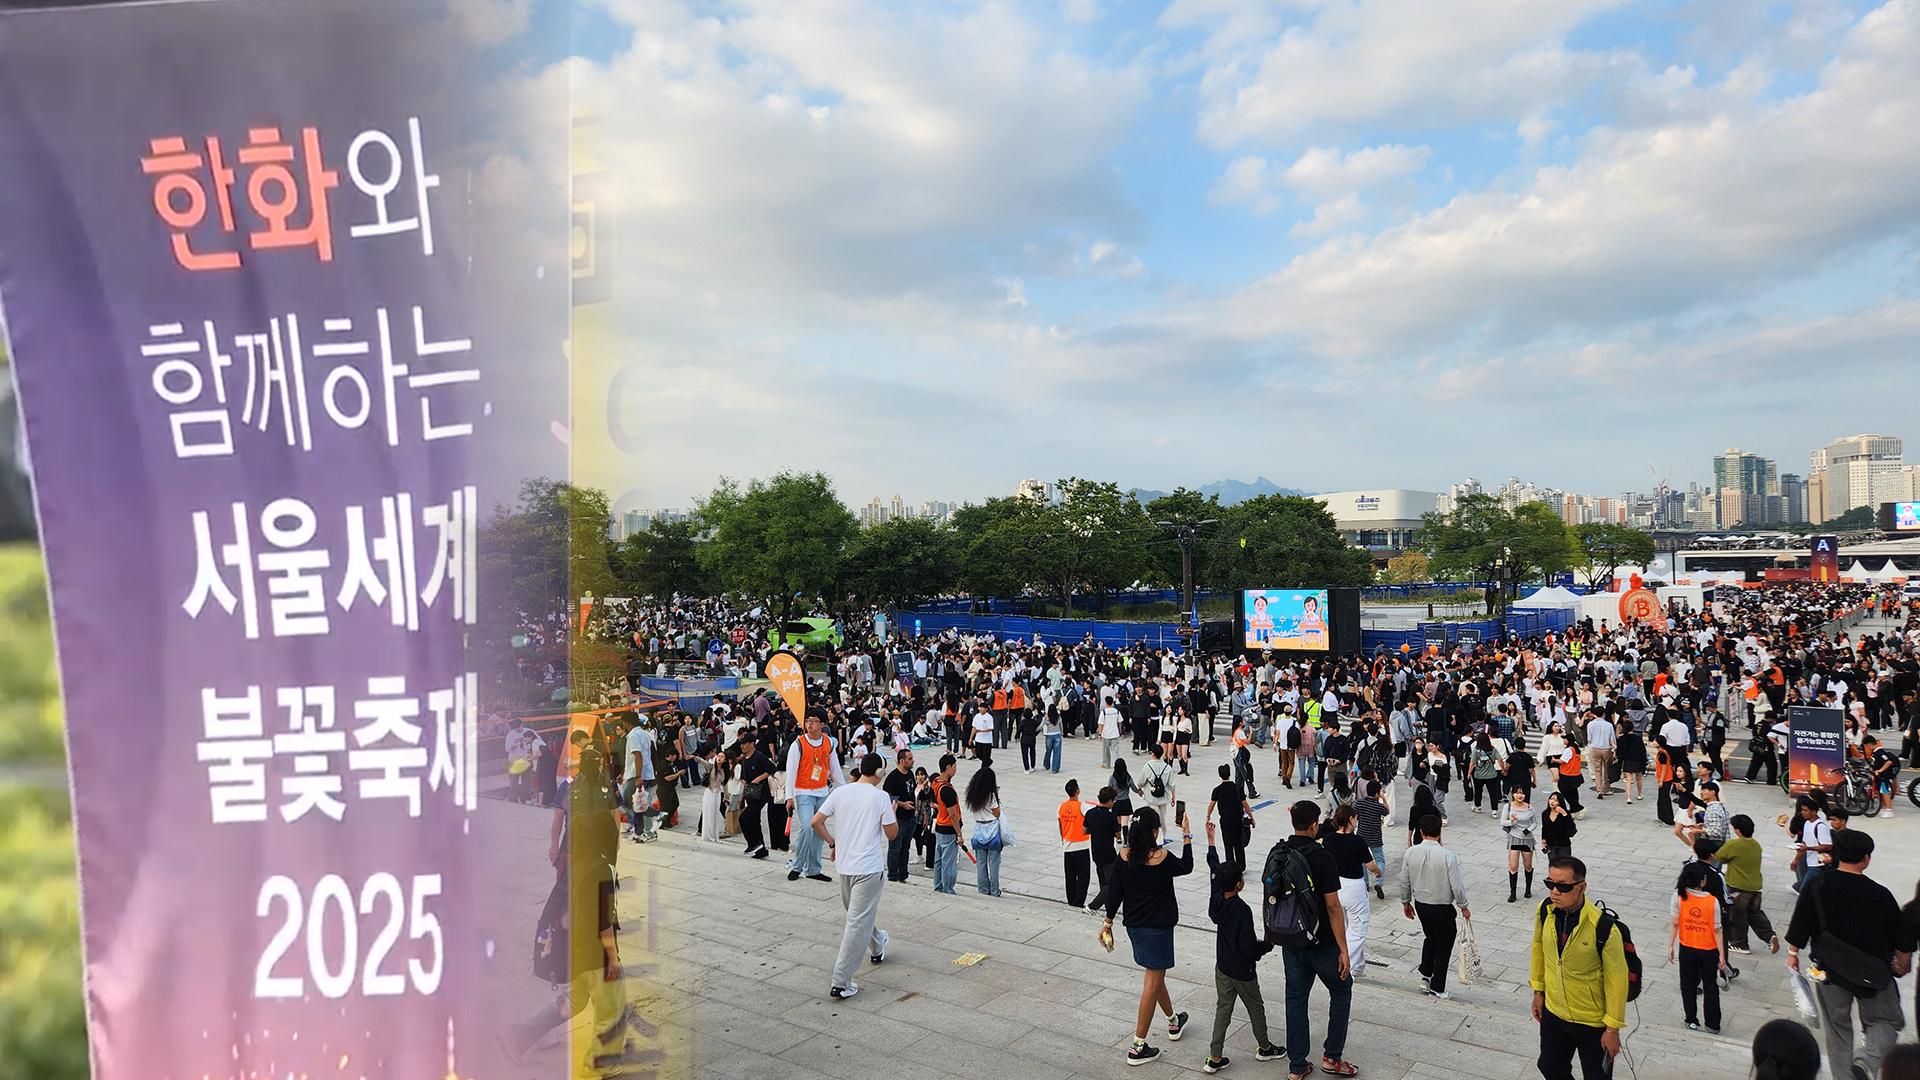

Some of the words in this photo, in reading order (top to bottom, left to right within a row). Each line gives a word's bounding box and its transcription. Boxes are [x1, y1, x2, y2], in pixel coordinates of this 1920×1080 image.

[140, 117, 440, 271] 한화와
[140, 305, 481, 459] 함께하는
[182, 486, 478, 639] 서울세계
[1816, 539, 1830, 552] A
[196, 672, 478, 824] 불꽃축제
[254, 872, 444, 998] 2025
